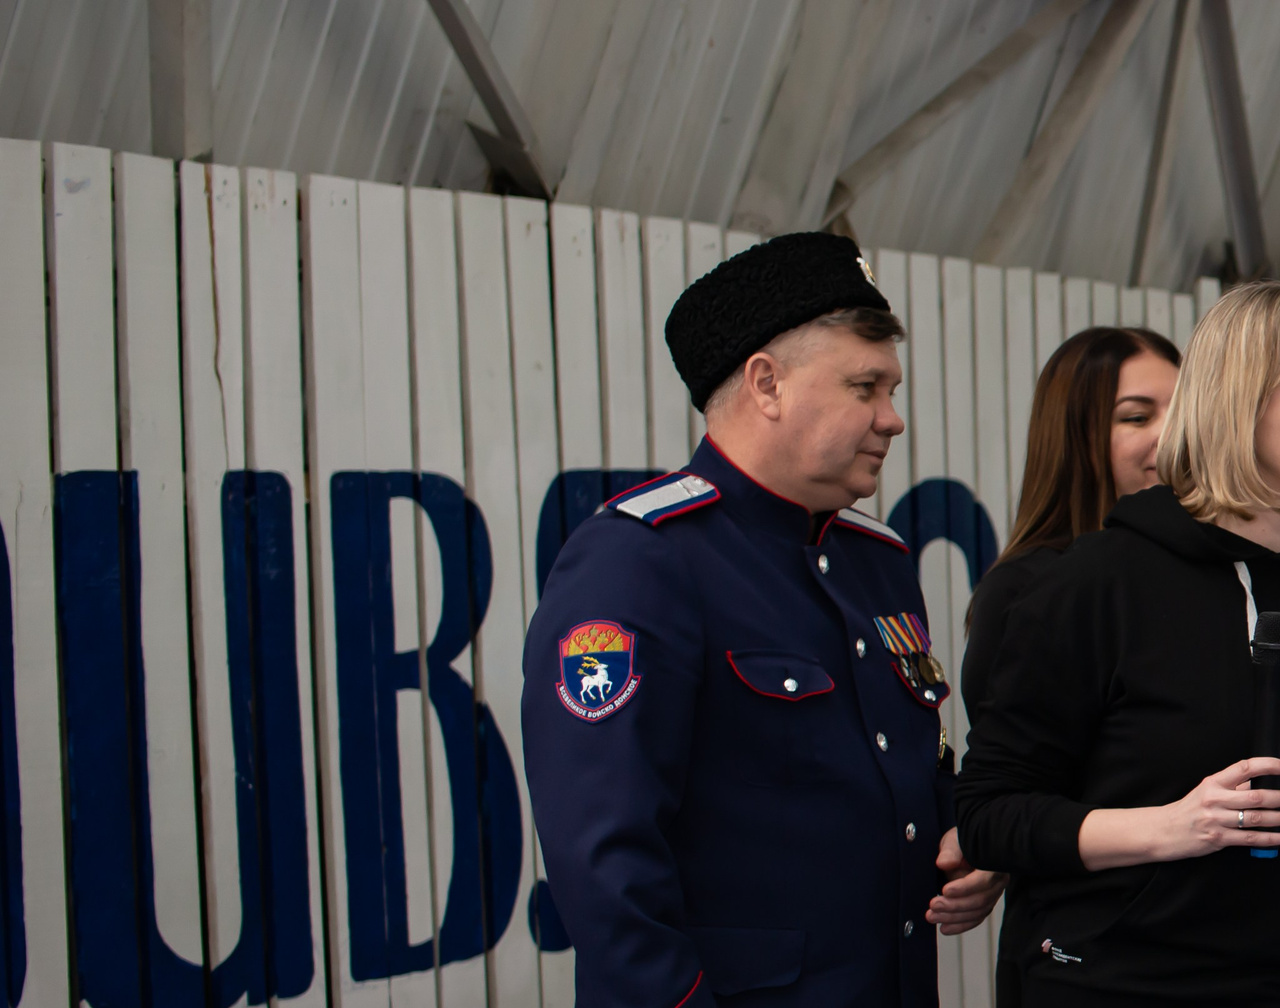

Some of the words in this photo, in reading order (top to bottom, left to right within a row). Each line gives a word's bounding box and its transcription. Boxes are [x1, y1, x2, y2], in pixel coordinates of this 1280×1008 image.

[559, 685, 588, 717] ВСЕВЕЛИКОЕ
[587, 704, 614, 718] ВОЙСКО
[613, 678, 638, 708] ДОНСКОЕ
